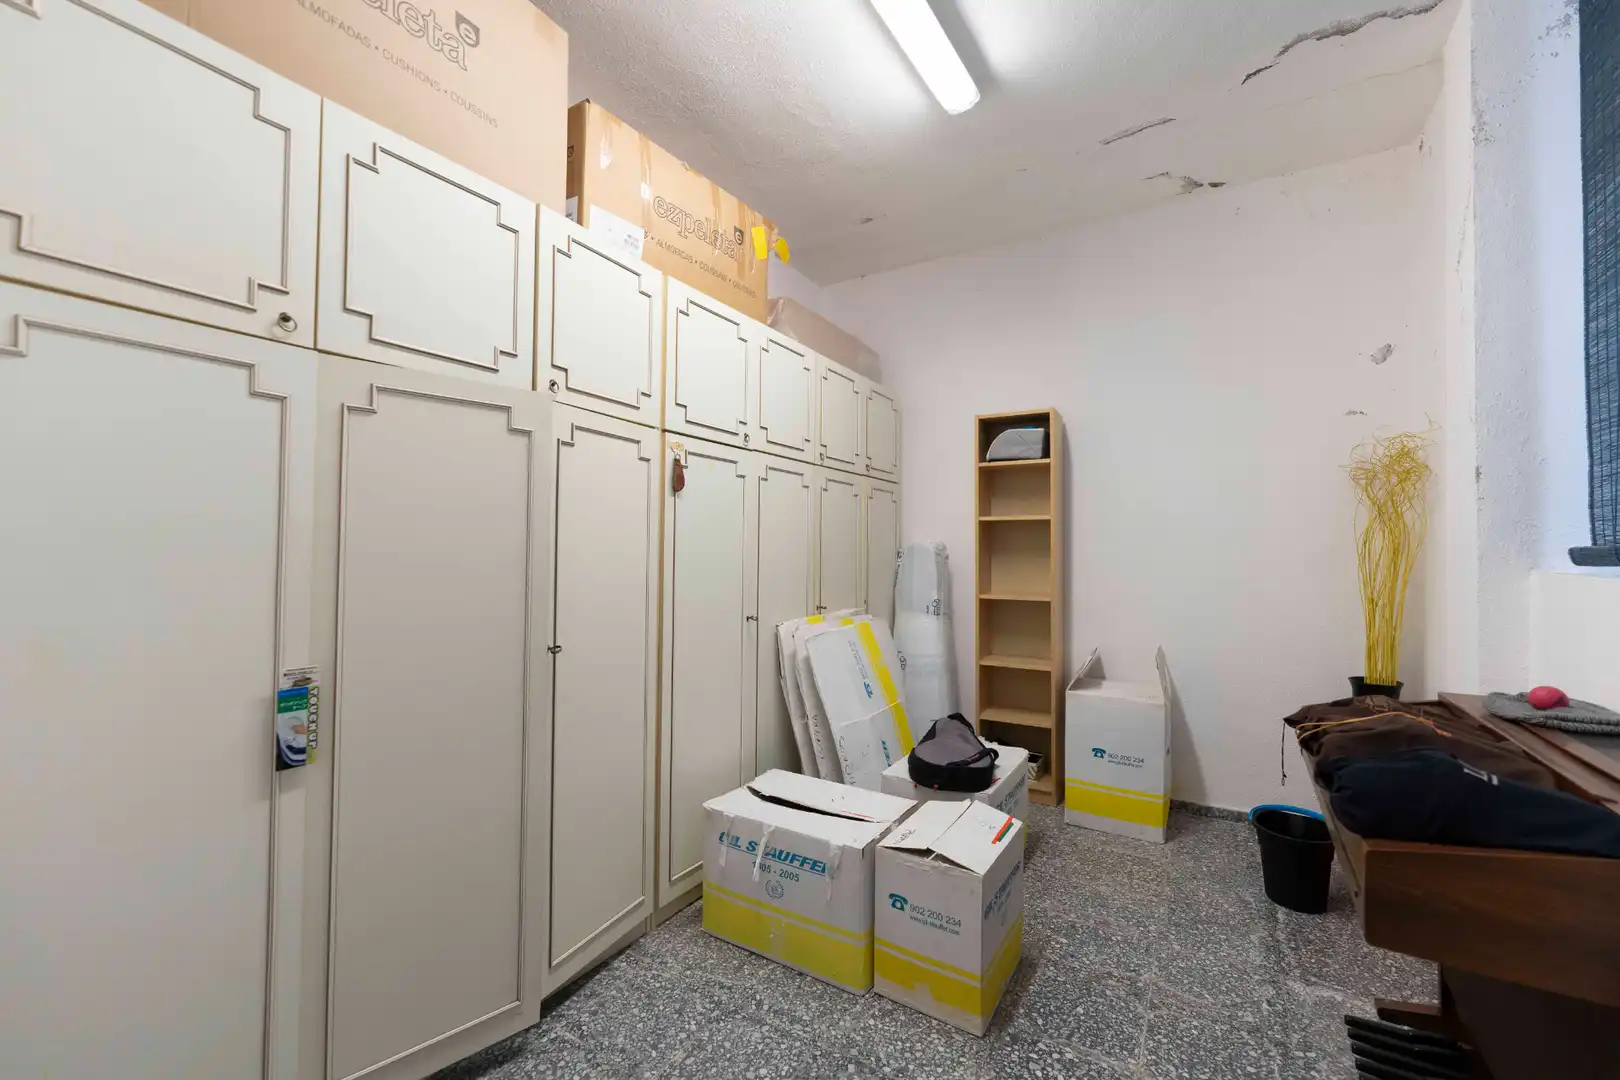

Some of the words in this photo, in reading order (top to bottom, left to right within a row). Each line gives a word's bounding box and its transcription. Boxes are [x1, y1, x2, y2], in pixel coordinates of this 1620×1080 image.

[362, 0, 468, 71] leta
[297, 0, 372, 48] LMOFADAS
[382, 48, 441, 92] CUSHIONS
[450, 91, 498, 128] COUSSINS
[653, 196, 741, 261] ezpeleta
[309, 686, 320, 731] TOUCH
[745, 840, 826, 874] SAUFFE
[779, 868, 800, 883] 2005
[909, 903, 925, 917] 902
[927, 909, 944, 922] 200
[945, 915, 962, 928] 234
